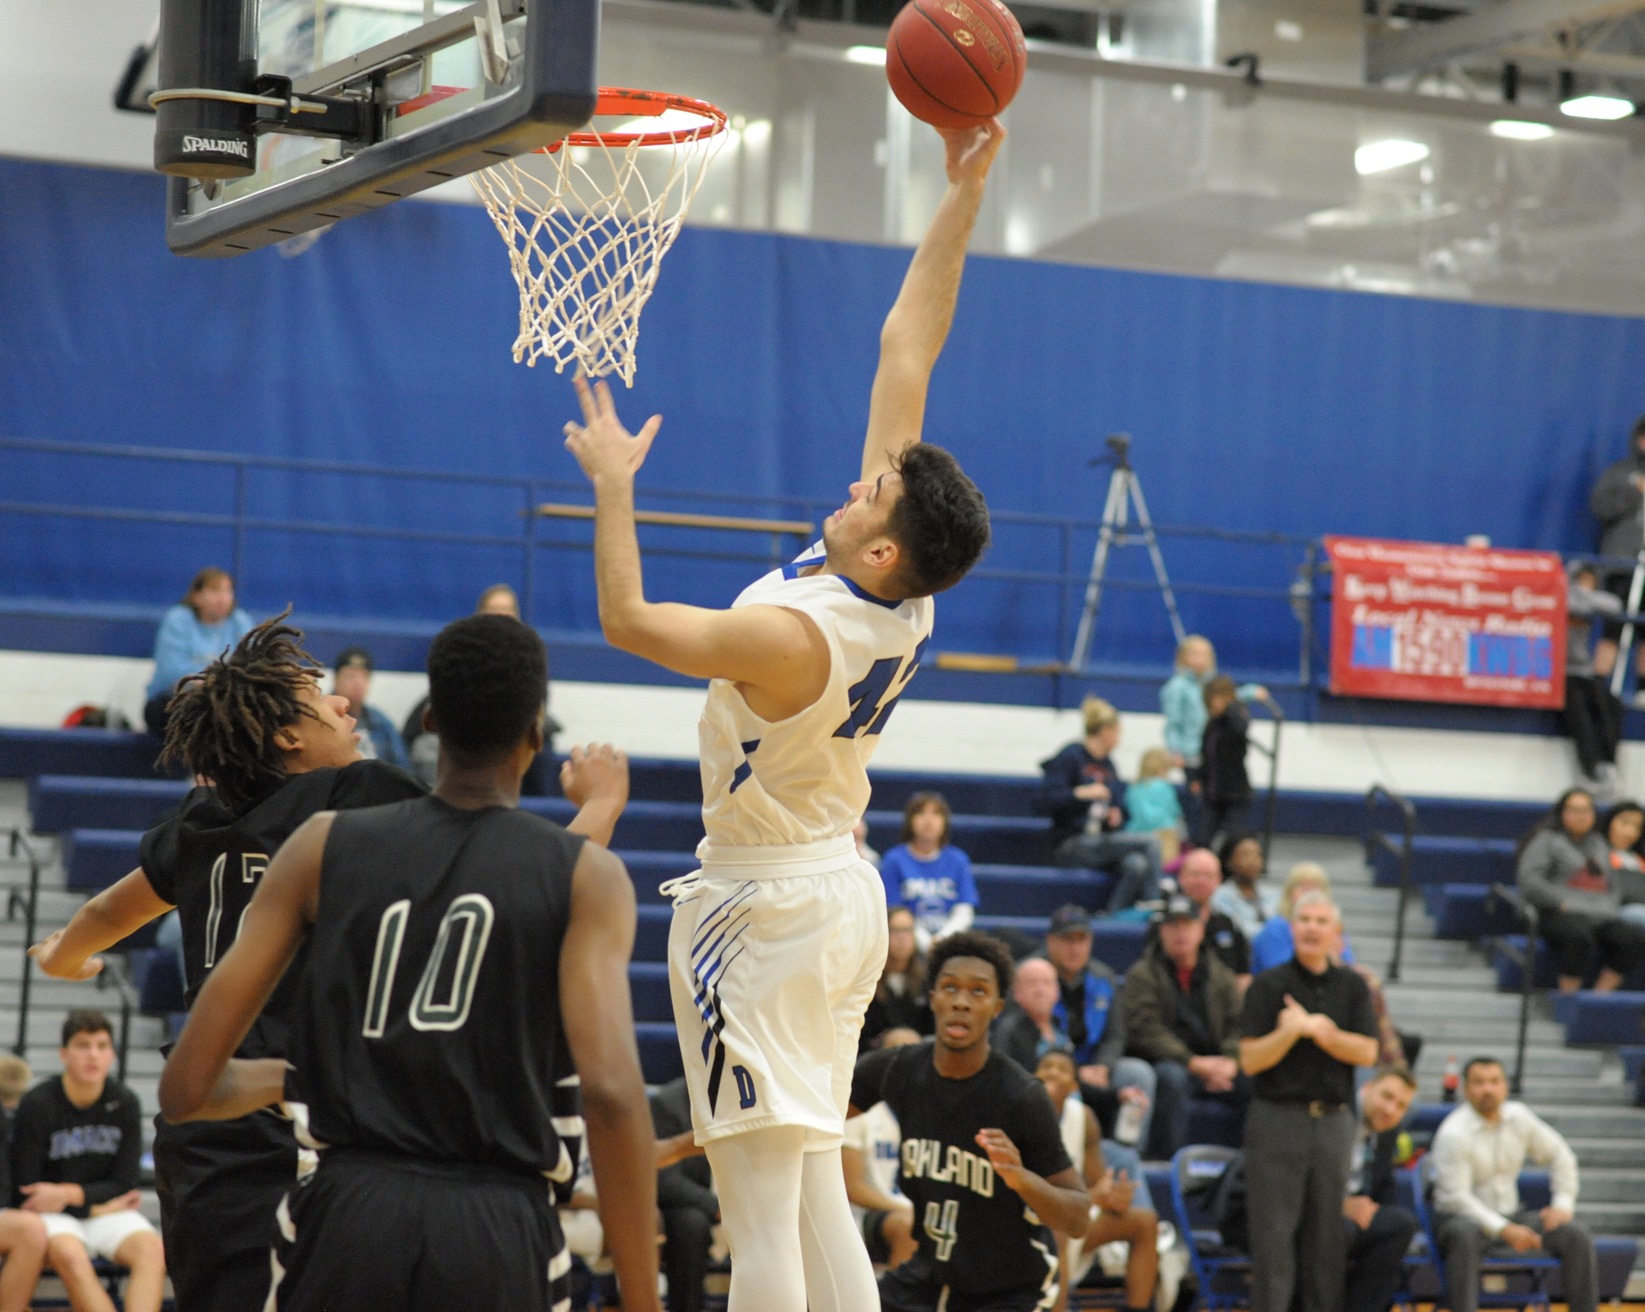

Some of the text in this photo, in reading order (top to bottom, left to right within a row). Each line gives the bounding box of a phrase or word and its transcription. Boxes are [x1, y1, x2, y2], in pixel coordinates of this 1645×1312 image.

[182, 135, 248, 158] SPALDING
[362, 893, 495, 1038] 10
[732, 1065, 757, 1110] D
[924, 1200, 959, 1262] 4
